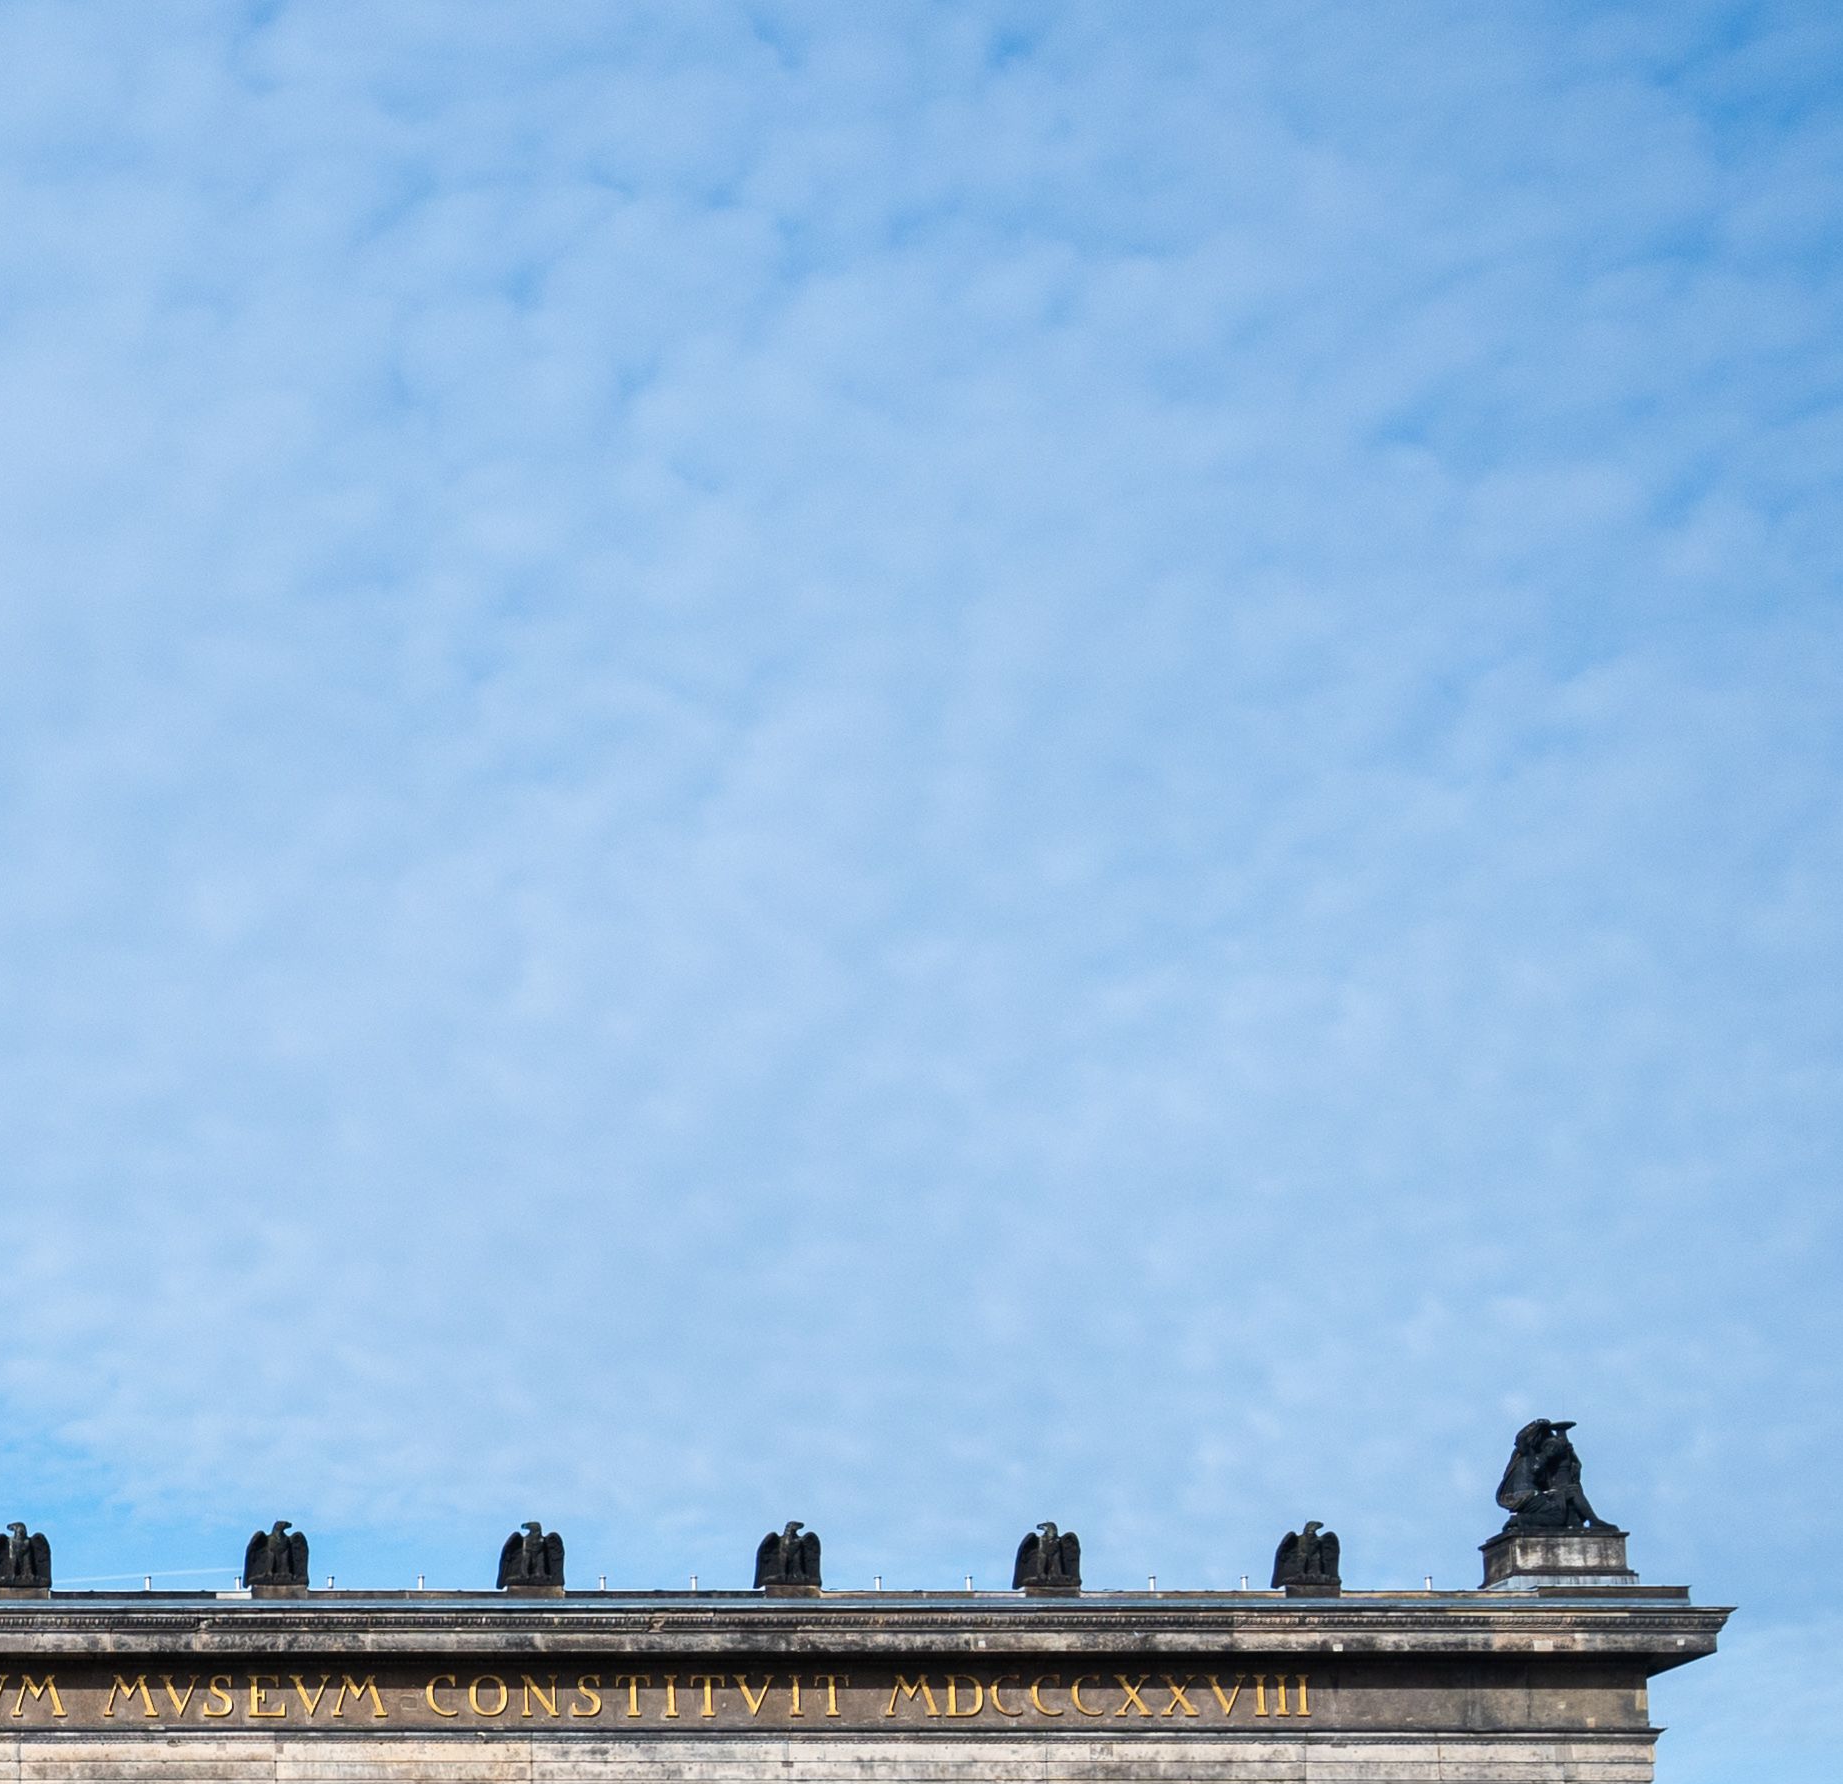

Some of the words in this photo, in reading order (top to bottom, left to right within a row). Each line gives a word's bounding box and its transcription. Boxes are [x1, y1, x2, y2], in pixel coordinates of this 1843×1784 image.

[104, 1675, 389, 1717] MVSEVM
[425, 1675, 847, 1717] CONSTITVIT
[886, 1675, 1311, 1717] MDCCCXXVIII
